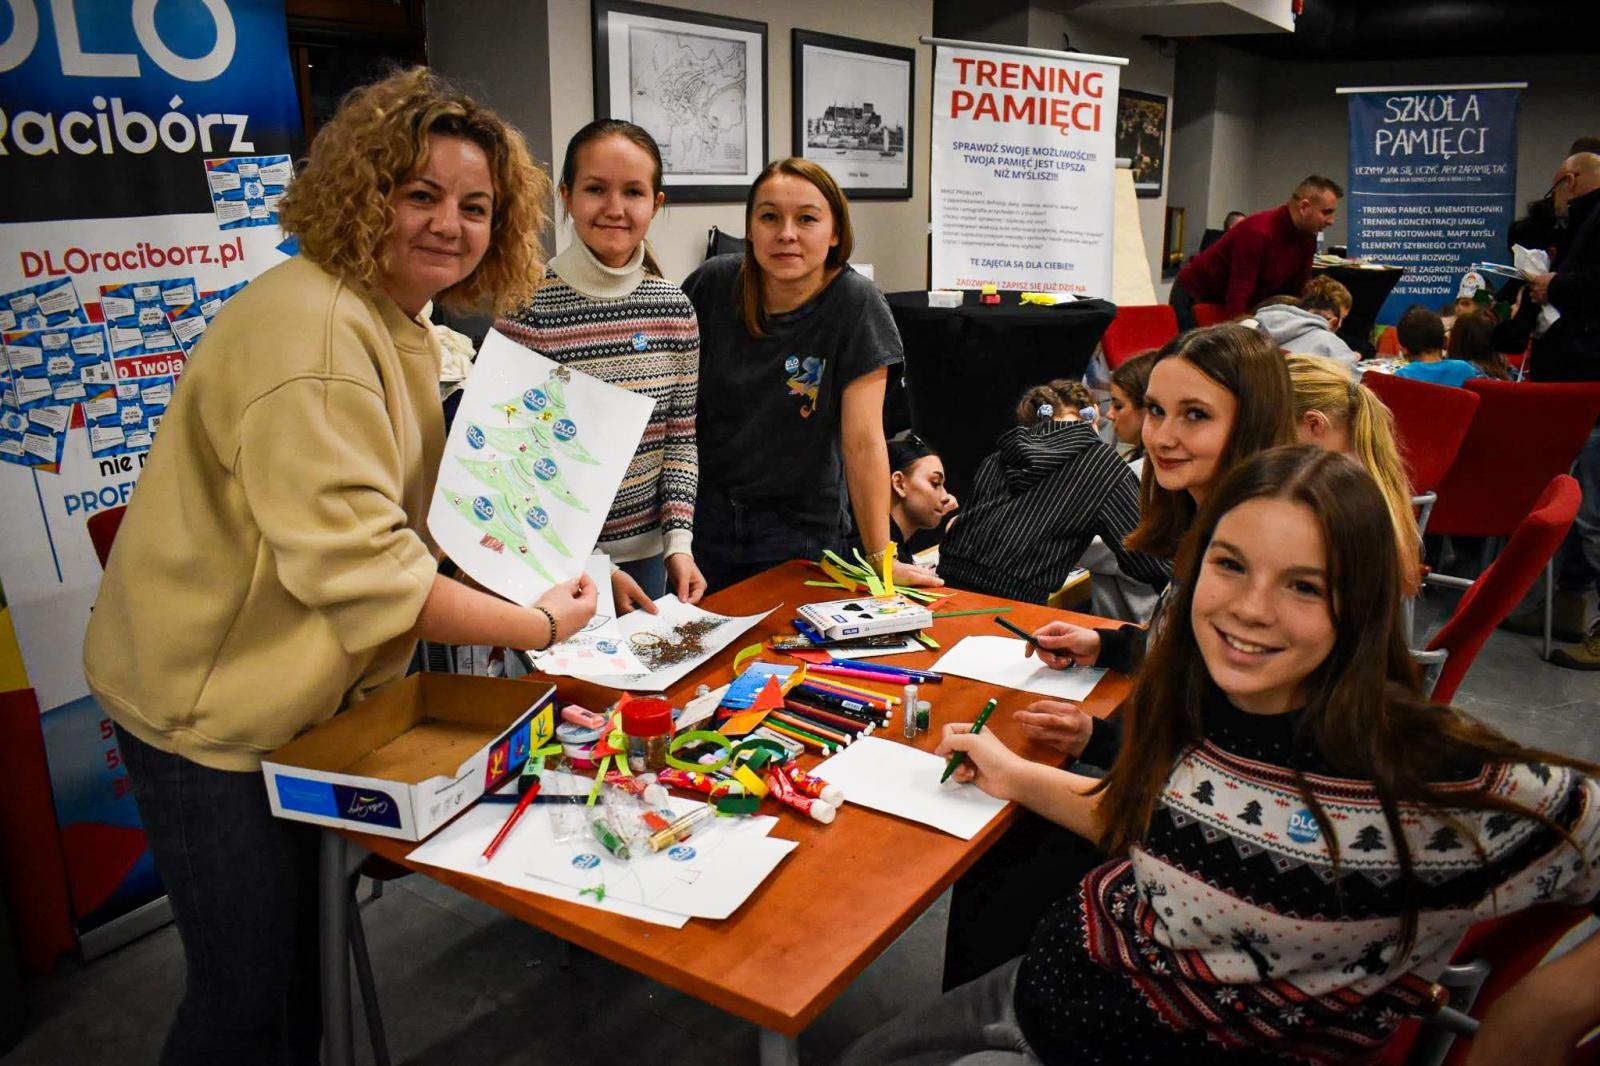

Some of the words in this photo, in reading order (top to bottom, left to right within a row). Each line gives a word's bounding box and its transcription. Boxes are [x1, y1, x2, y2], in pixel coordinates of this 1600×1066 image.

[0, 0, 236, 82] LO
[953, 57, 1103, 98] TRENING
[951, 90, 1101, 136] PAMIĘCI
[1384, 94, 1480, 123] SZKOŁA
[0, 94, 256, 156] acibórz
[953, 141, 998, 153] SPRAWDŹ
[1000, 145, 1030, 157] SWOJE
[1375, 127, 1489, 160] PAMIĘCI
[964, 154, 995, 167] TWOJA
[998, 156, 1032, 170] PAMIĘĆ
[1034, 159, 1054, 170] JEST
[1056, 161, 1086, 172] LEPSZA
[1355, 166, 1384, 175] UCZYMY
[994, 168, 1010, 178] NIŻ
[1362, 206, 1397, 214] TRENING
[1398, 206, 1432, 215] PAMIĘCI,
[1434, 205, 1503, 214] MNEMOTECHNIKI
[1398, 218, 1456, 226] KONCENTRACJI
[1458, 217, 1485, 225] UWAGI
[1446, 229, 1469, 237] MAPY
[1471, 228, 1495, 237] MYŚLI
[1447, 241, 1486, 249] CZYTANIA
[20, 237, 244, 279] DLOraciborz.pl
[970, 257, 980, 266] TE
[981, 258, 1012, 269] ZAJĘCIA
[1025, 261, 1042, 269] DLA
[1421, 253, 1460, 262] ROZWOJU
[1002, 281, 1028, 289] ZAPISZ
[1030, 282, 1041, 292] SIĘ
[1042, 282, 1057, 293] JUŻ
[1408, 285, 1451, 294] TALENTÓW
[526, 389, 547, 405] DLO
[468, 426, 485, 445] DLO
[555, 421, 576, 435] DLO
[100, 455, 133, 477] nie
[536, 460, 557, 476] DLO
[475, 497, 494, 515] DLO
[529, 508, 548, 524] DLO
